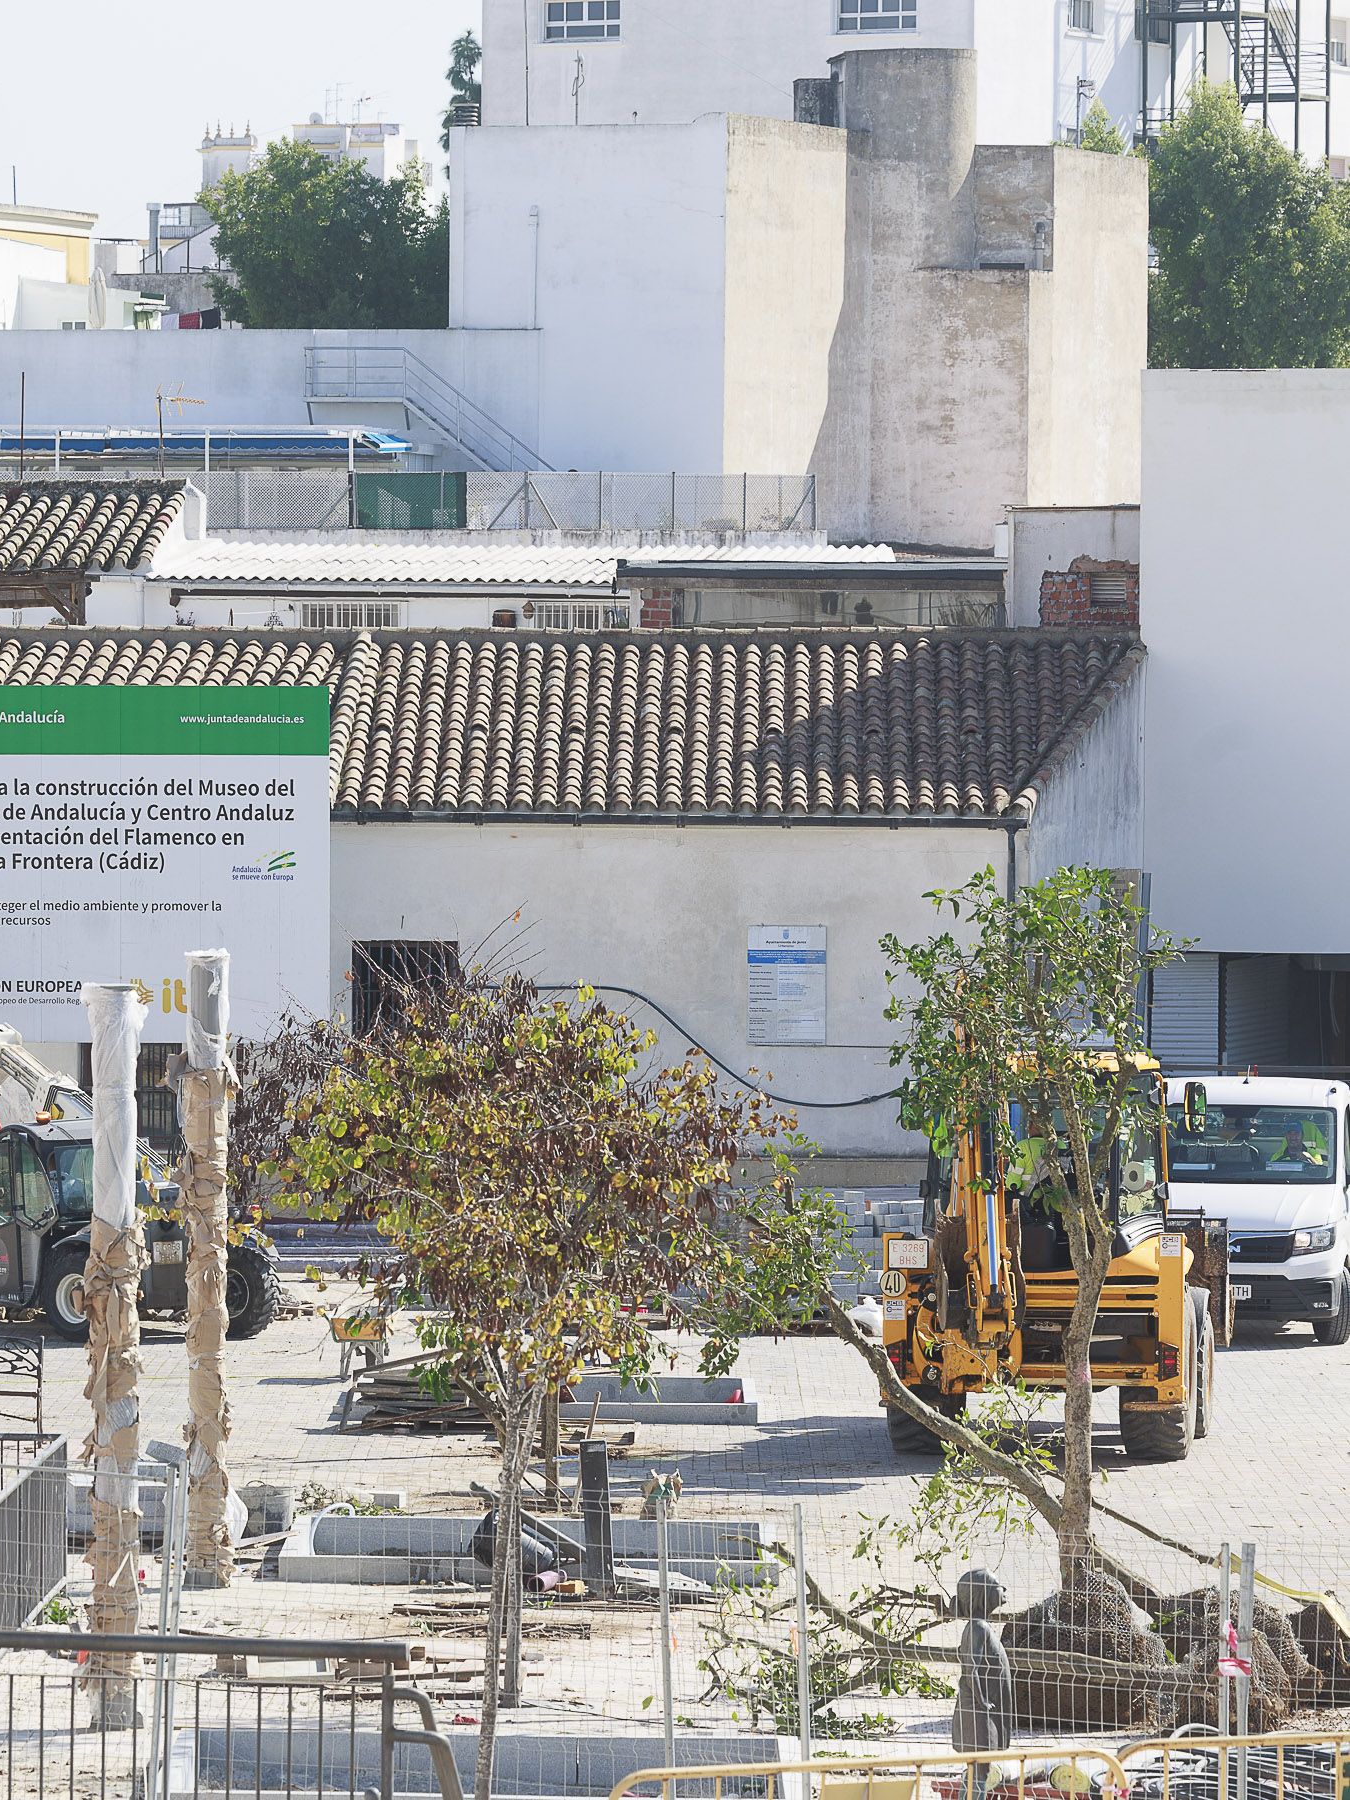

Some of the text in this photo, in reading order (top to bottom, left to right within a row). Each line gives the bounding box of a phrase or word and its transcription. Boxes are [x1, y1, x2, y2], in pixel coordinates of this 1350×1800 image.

[180, 713, 305, 726] www.juntadeandalucia.es
[14, 777, 30, 796] la
[36, 776, 158, 797] construcción
[164, 778, 194, 797] del
[199, 780, 260, 797] Museo
[265, 778, 295, 797] del
[3, 802, 26, 821] de
[31, 801, 126, 821] Andalucía
[131, 807, 142, 824] y
[147, 803, 212, 821] Centro
[216, 803, 295, 822] Andaluz
[90, 827, 119, 846] del
[125, 827, 217, 846] Flamenco
[222, 832, 245, 846] en
[12, 852, 93, 870] Frontera
[99, 850, 165, 874] (Cádiz)
[272, 873, 294, 881] Europa
[29, 899, 40, 911] el
[43, 899, 80, 911] medio
[83, 899, 139, 912] ambiente
[141, 902, 149, 914] y
[151, 902, 210, 914] promover
[211, 900, 222, 912] la
[1, 917, 51, 926] recursos
[16, 980, 82, 993] EUROPEA
[18, 997, 27, 1005] de
[29, 997, 65, 1005] Desarrollo
[892, 1243, 924, 1253] E 3269
[899, 1255, 917, 1265] BHS
[884, 1272, 901, 1294] 40
[1233, 1286, 1248, 1297] TH
